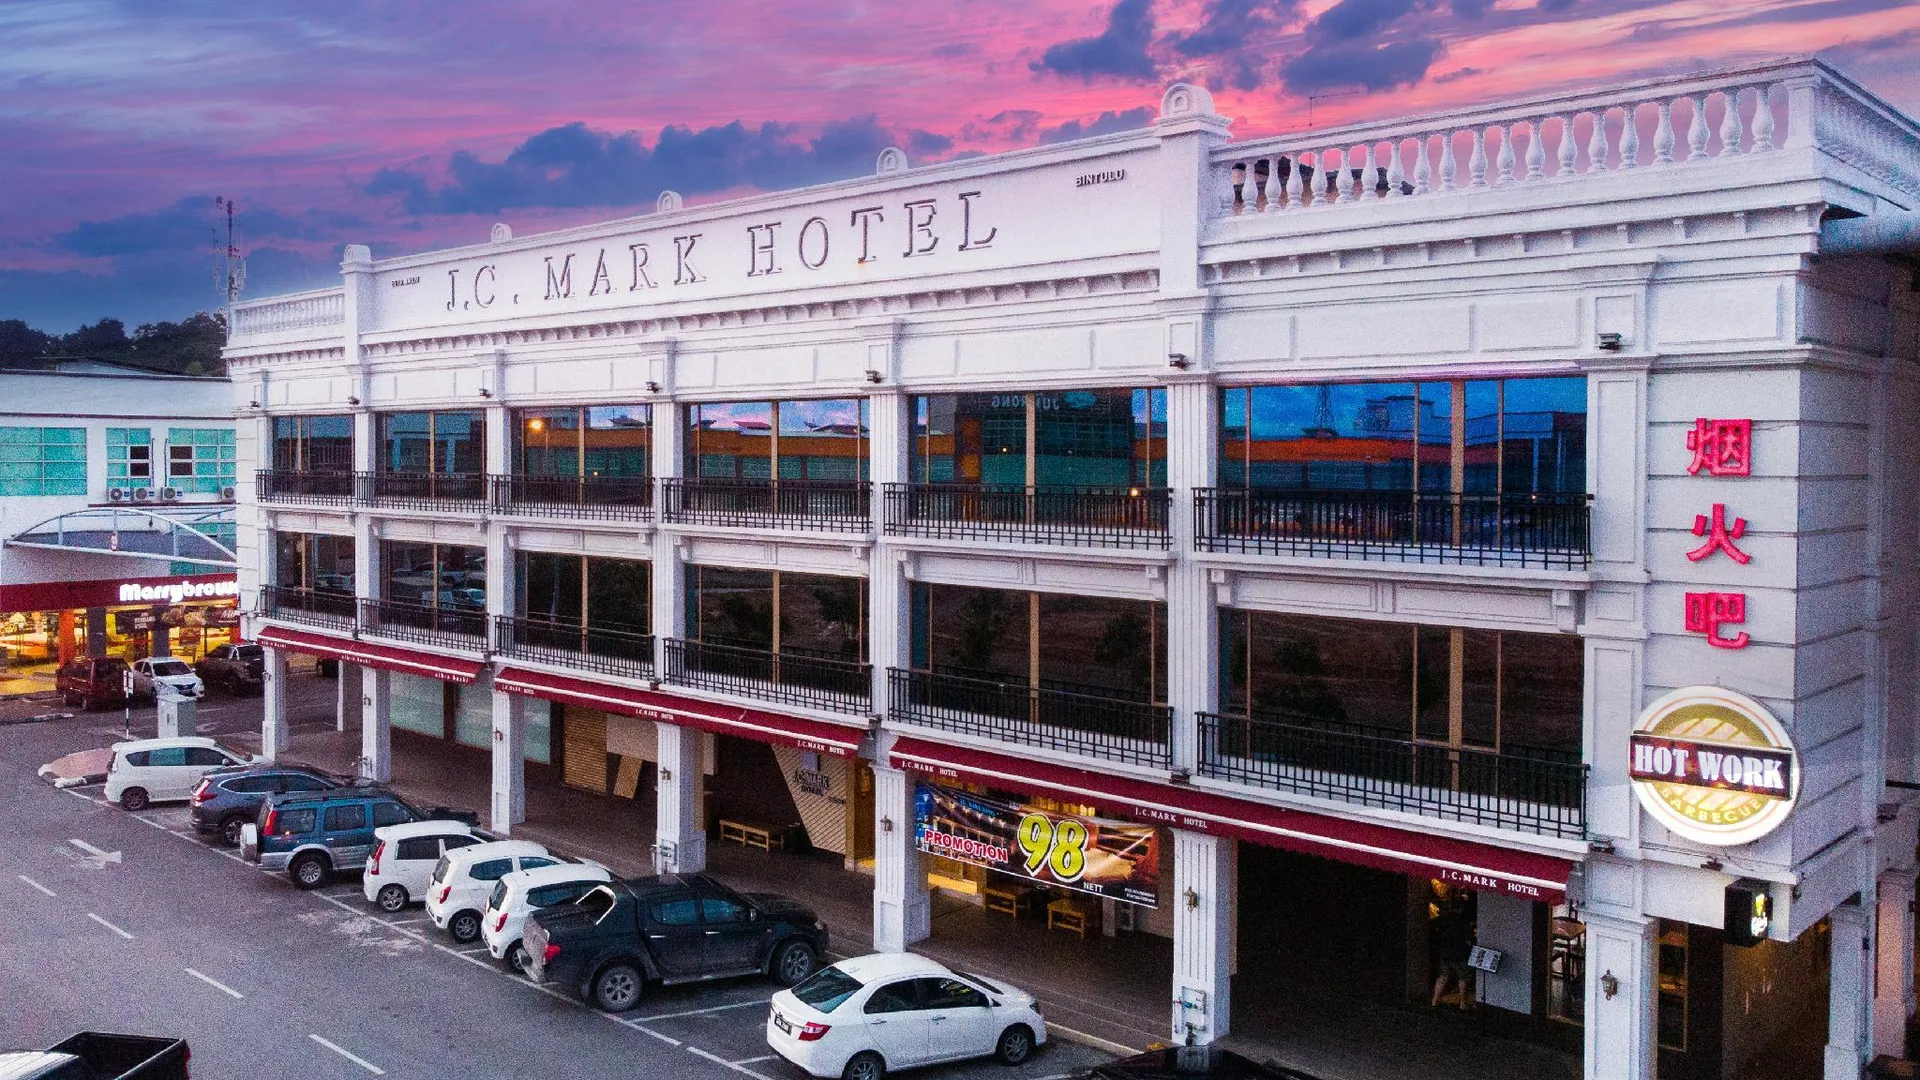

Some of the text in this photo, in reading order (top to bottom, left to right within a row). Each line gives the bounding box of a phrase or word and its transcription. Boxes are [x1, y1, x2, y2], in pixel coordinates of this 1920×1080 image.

[1076, 168, 1125, 188] BINTULU
[543, 233, 707, 302] MARK
[746, 190, 998, 278] HOTEL
[119, 581, 238, 603] Marrybrow
[902, 760, 958, 777] J.C.MARK HOTEL
[1634, 743, 1785, 790] HOT WORK
[1135, 806, 1208, 828] J.C.MARK HOTEL
[1661, 787, 1762, 824] BARBECUE
[924, 828, 1009, 864] PROMOTION
[1016, 813, 1089, 883] 98
[1083, 881, 1104, 893] NETT
[1442, 869, 1540, 897] J.C.MARK HOTEL
